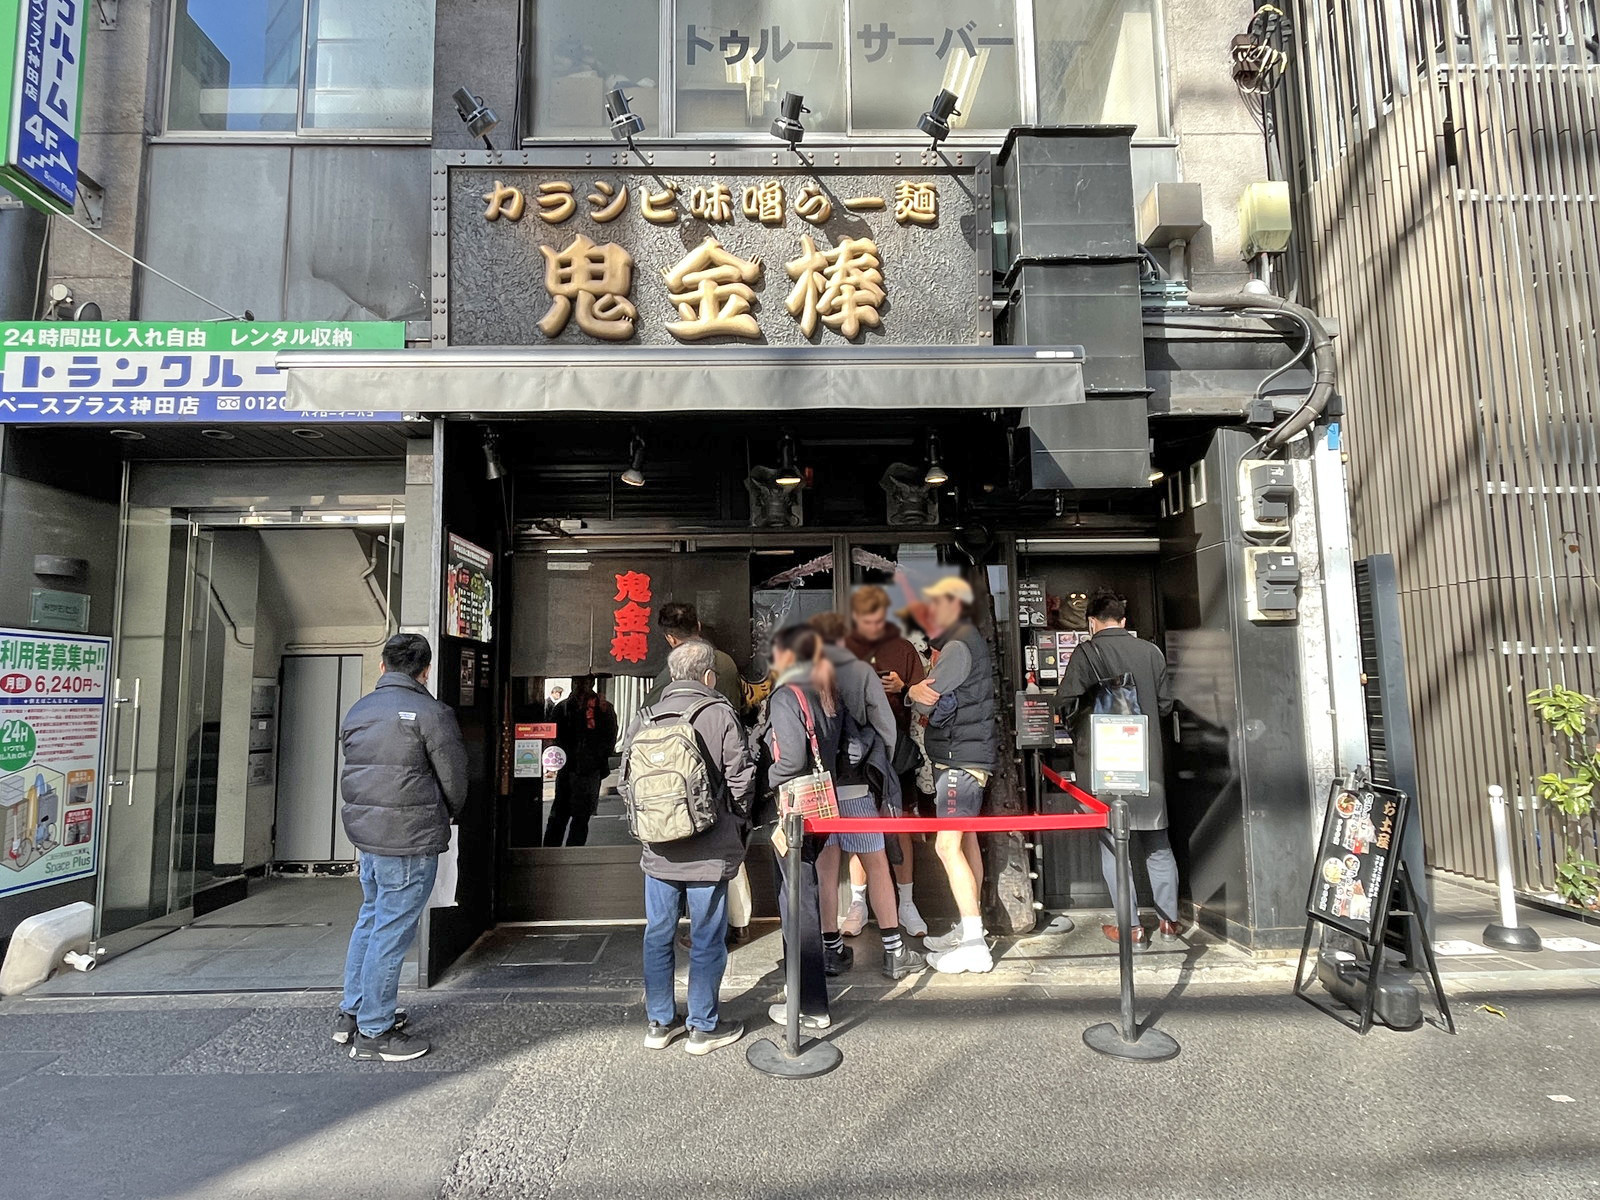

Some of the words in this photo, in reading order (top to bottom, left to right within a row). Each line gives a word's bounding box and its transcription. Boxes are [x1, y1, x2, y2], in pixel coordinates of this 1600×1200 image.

[686, 24, 833, 65] トゥルー
[856, 21, 1014, 63] サーバー
[25, 114, 59, 151] 4F
[483, 180, 938, 226] カラシビ味噌らー麺
[536, 233, 887, 342] 鬼金棒
[3, 328, 207, 348] 24時間出し入れ自由
[231, 328, 353, 347] レンタル収納
[610, 571, 652, 663] 鬼金棒
[2, 720, 29, 743] 24H
[45, 861, 71, 874] Space
[72, 856, 91, 867] Plus
